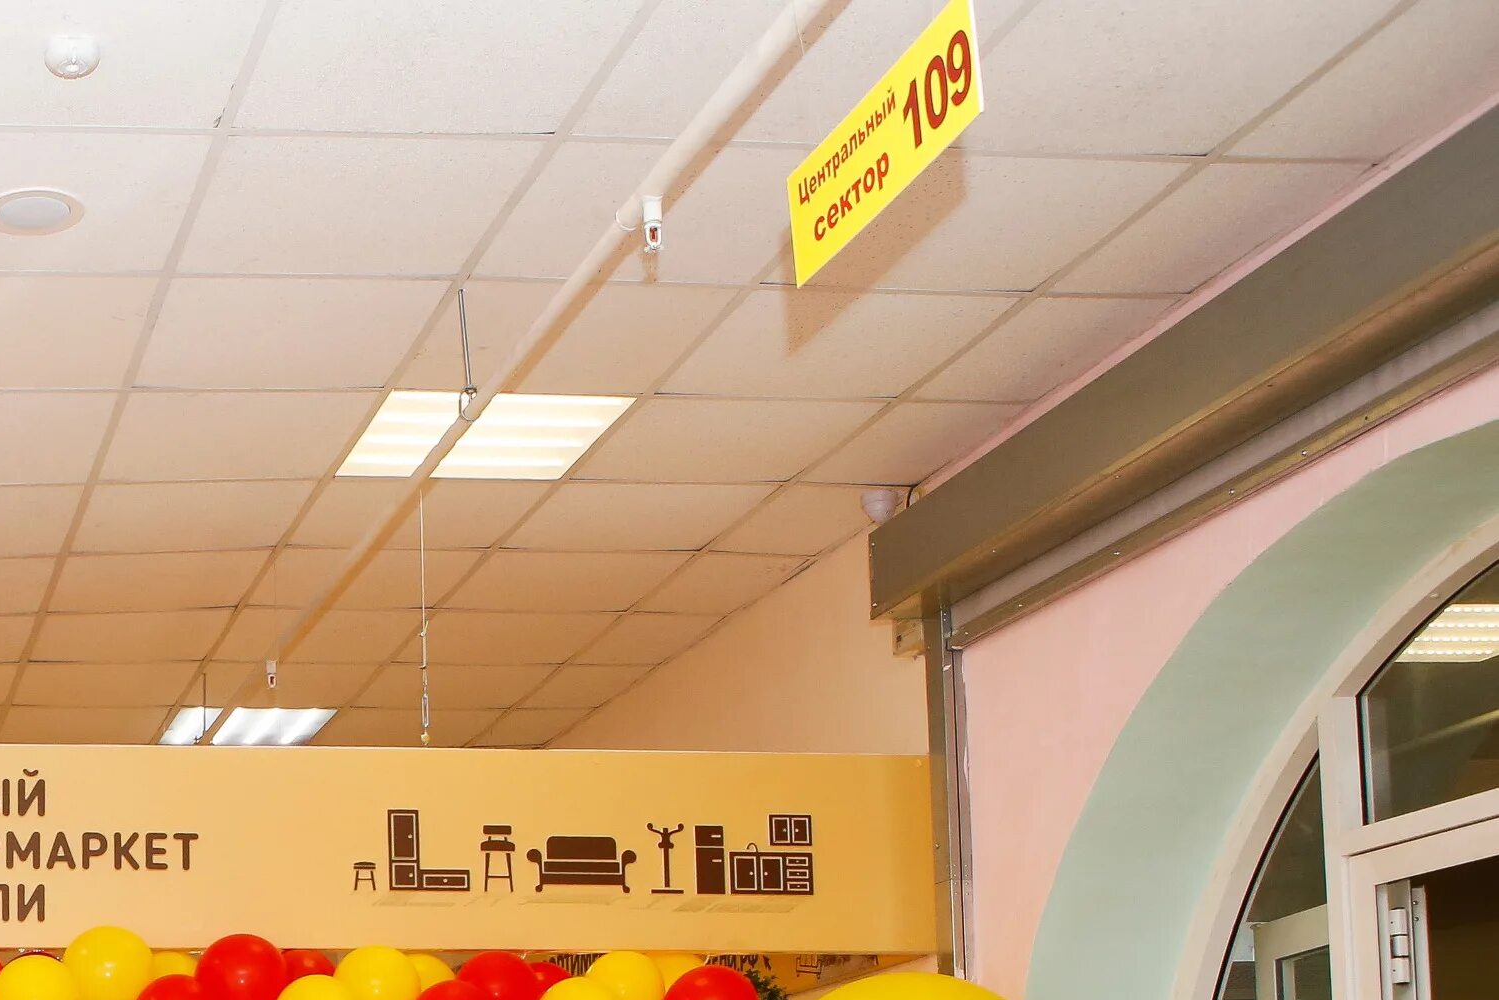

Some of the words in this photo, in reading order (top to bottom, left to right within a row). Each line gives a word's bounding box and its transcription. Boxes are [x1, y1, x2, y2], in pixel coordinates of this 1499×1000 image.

[798, 85, 897, 206] Центральный
[814, 152, 890, 241] сектор
[903, 30, 972, 149] 109
